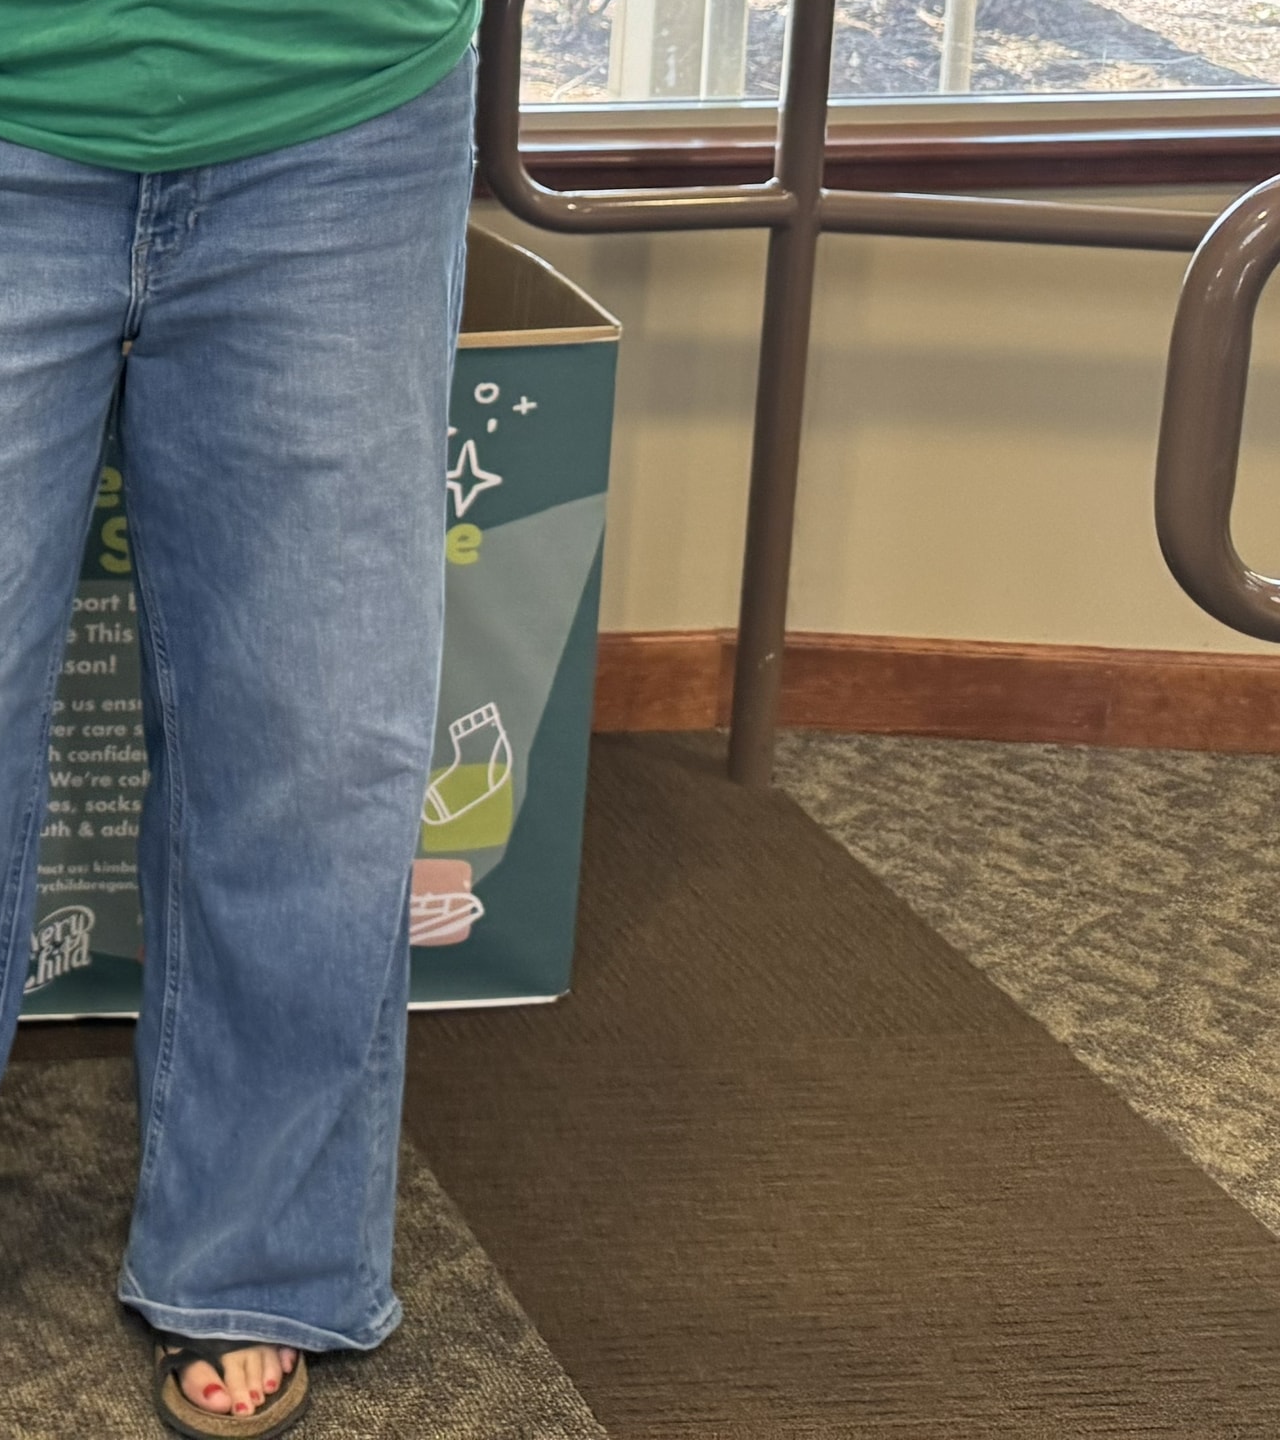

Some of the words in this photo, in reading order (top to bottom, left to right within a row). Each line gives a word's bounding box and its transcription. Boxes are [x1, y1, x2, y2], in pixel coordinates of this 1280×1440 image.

[87, 623, 134, 643] This
[72, 699, 95, 711] us
[83, 724, 127, 737] care
[79, 822, 94, 837] &
